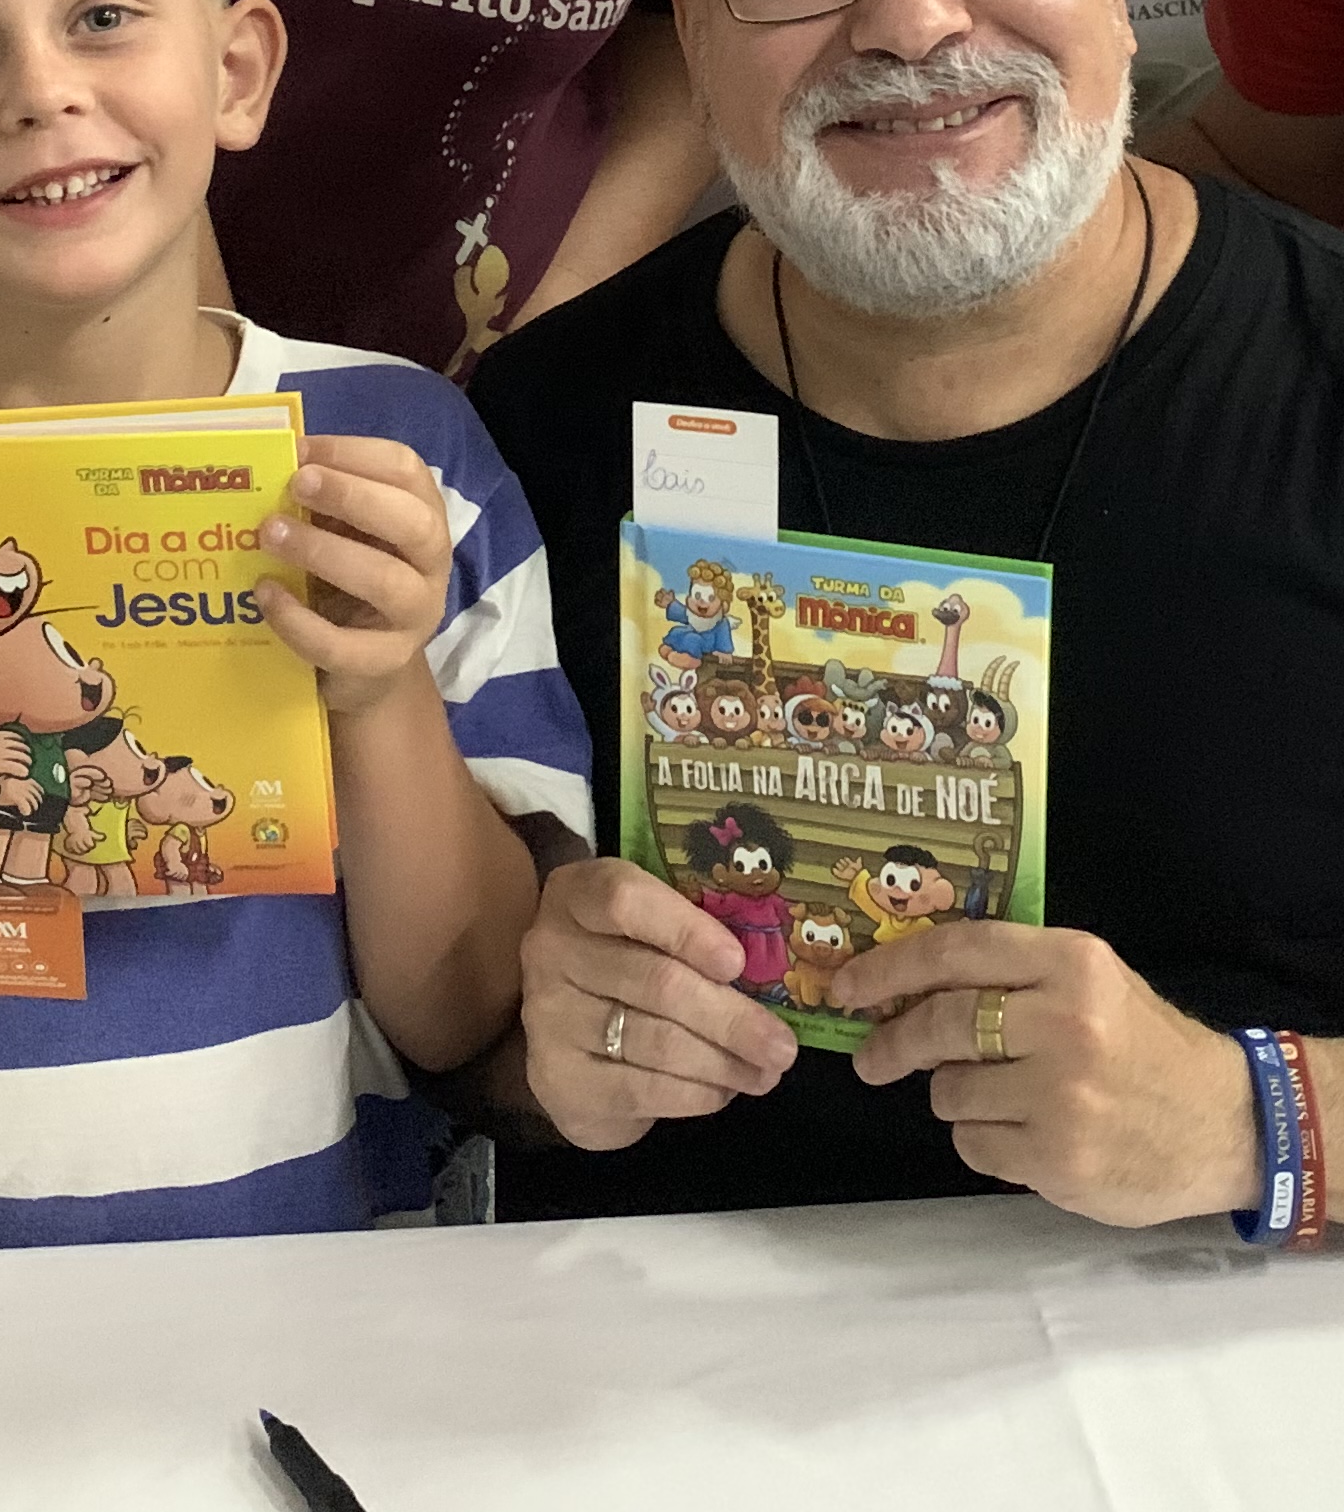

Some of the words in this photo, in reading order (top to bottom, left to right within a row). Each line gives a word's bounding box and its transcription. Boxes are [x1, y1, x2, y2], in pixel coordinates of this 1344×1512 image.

[76, 467, 134, 482] TURMA
[94, 483, 121, 496] DA
[84, 525, 151, 556] Dia
[160, 530, 187, 553] a
[197, 523, 261, 553] dia
[133, 557, 219, 583] com
[810, 575, 871, 598] TURMA
[878, 584, 906, 604] DA
[95, 582, 266, 629] Jesus
[657, 756, 673, 787] A
[681, 758, 744, 793] FOLIA
[753, 765, 784, 797] NA
[794, 755, 886, 811] ARCA
[896, 783, 927, 818] DE
[935, 772, 1002, 826] NOÉ
[1301, 1170, 1316, 1224] MARIA
